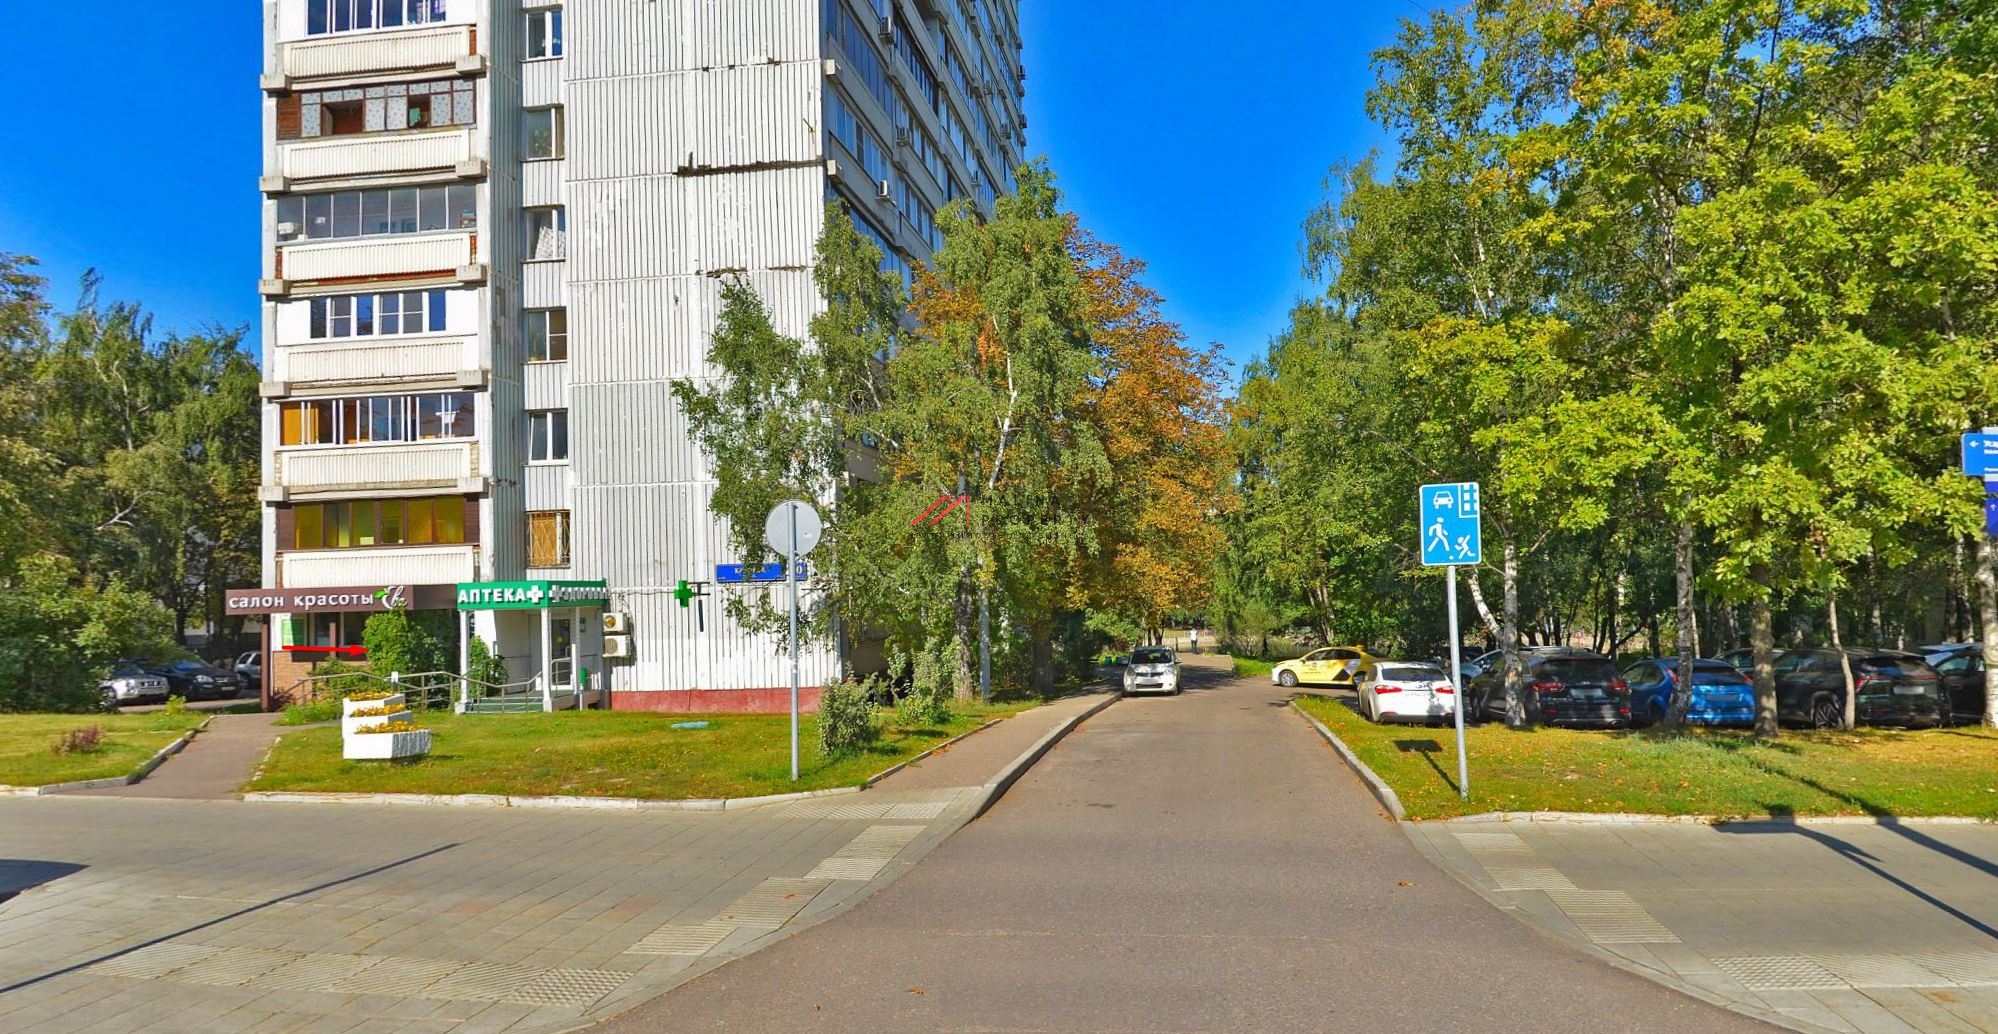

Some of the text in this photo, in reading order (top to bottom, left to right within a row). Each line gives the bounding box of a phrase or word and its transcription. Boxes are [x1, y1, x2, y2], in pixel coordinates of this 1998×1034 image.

[228, 594, 285, 609] салон
[294, 592, 374, 611] красоты
[458, 587, 527, 603] АПТЕКА
